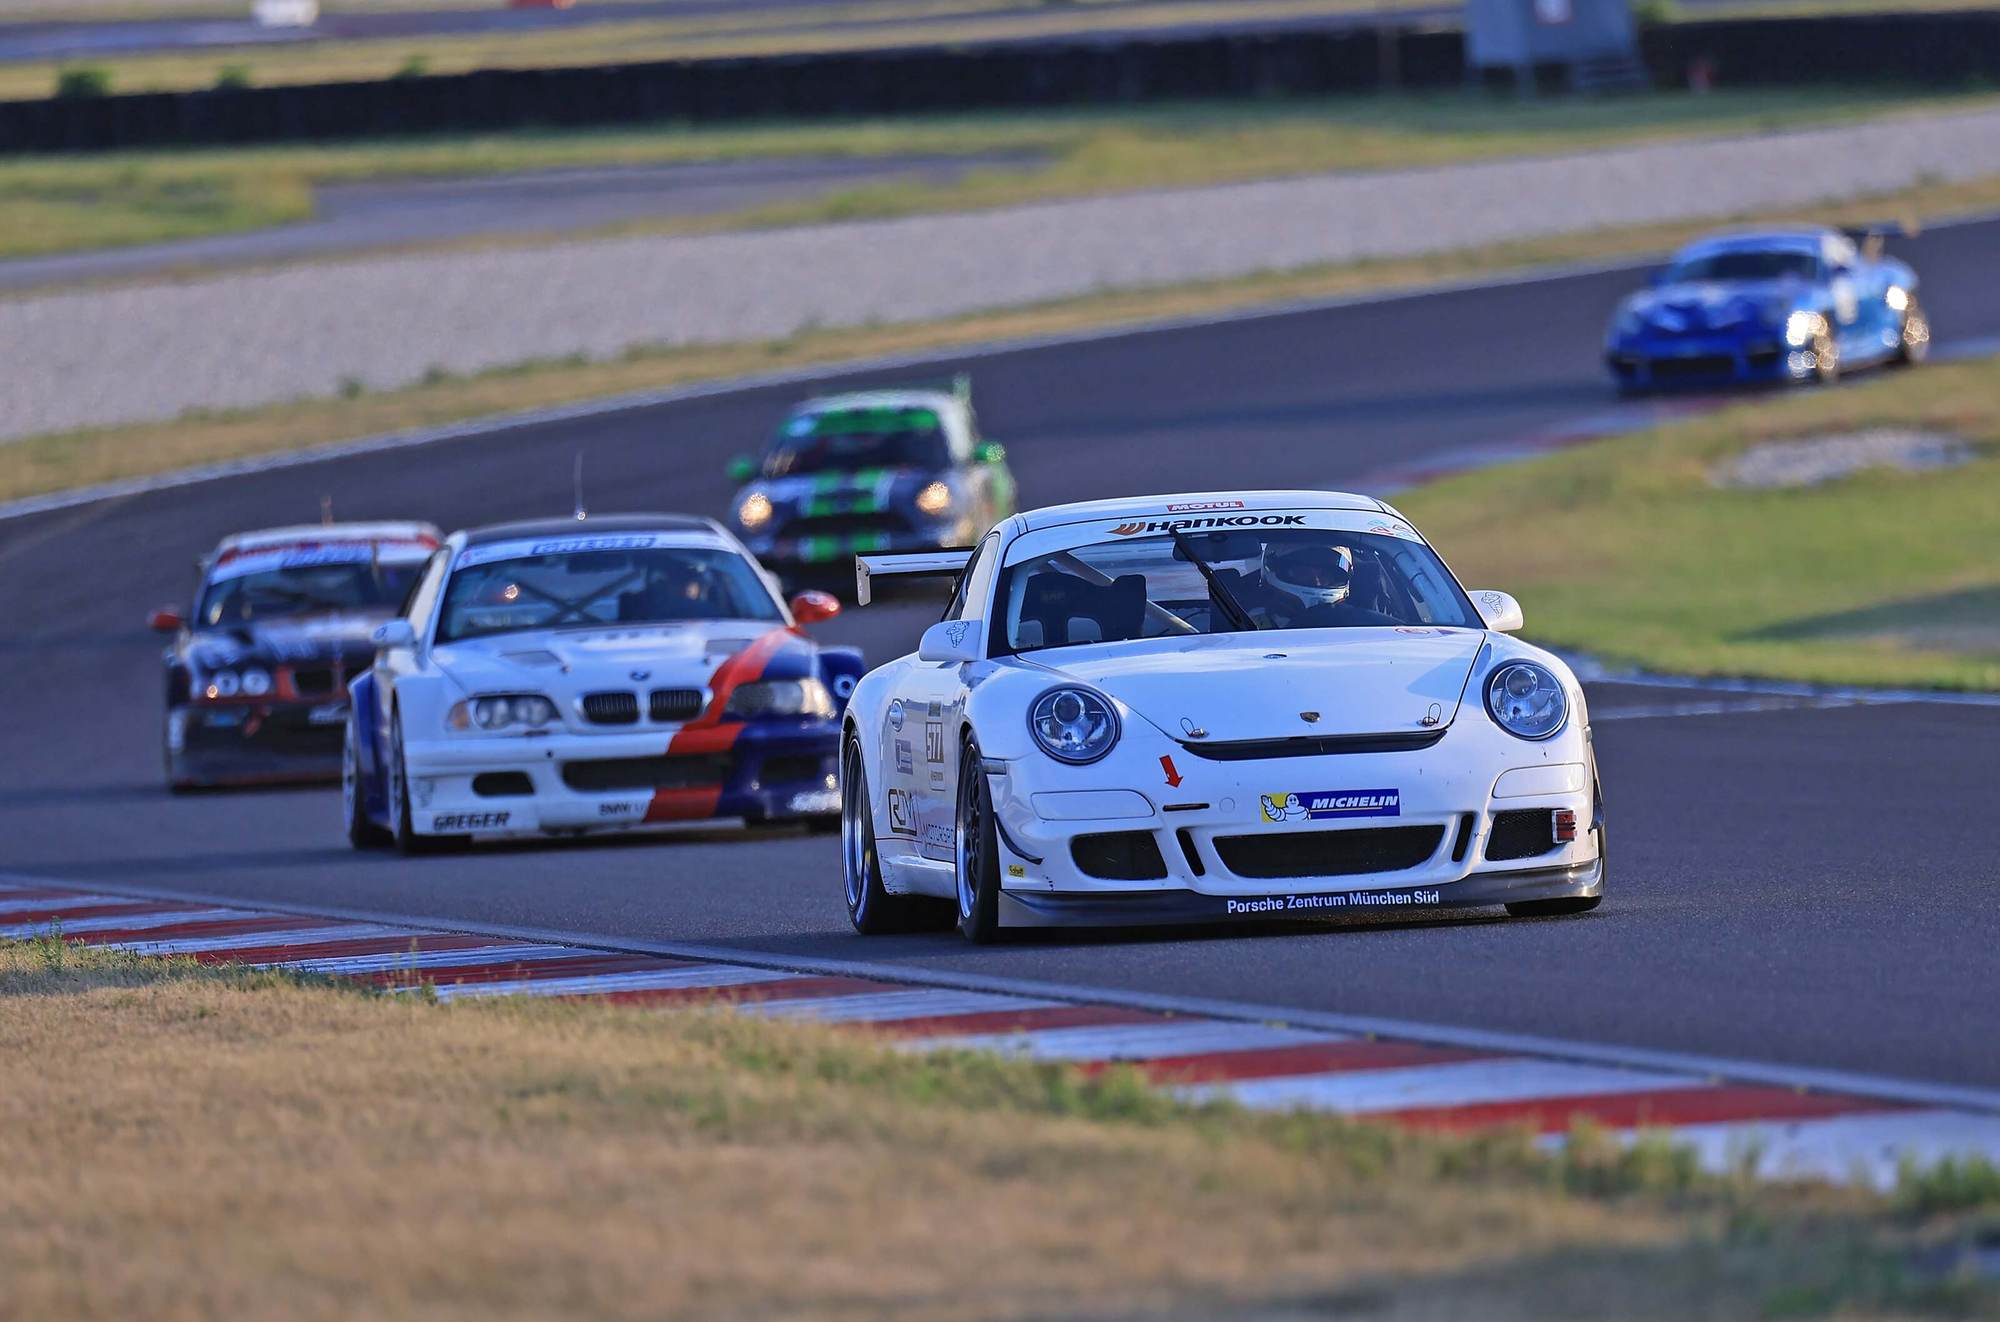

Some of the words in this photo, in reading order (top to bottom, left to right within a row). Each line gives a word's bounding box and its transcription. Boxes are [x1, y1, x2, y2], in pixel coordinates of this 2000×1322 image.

[1171, 500, 1240, 511] MOTUL
[1311, 795, 1399, 809] MICHELIN
[433, 812, 511, 832] GREGER
[1227, 898, 1284, 914] Porsche
[1286, 895, 1346, 910] Zentrum
[1350, 891, 1412, 905] München
[1414, 890, 1440, 904] Süd
